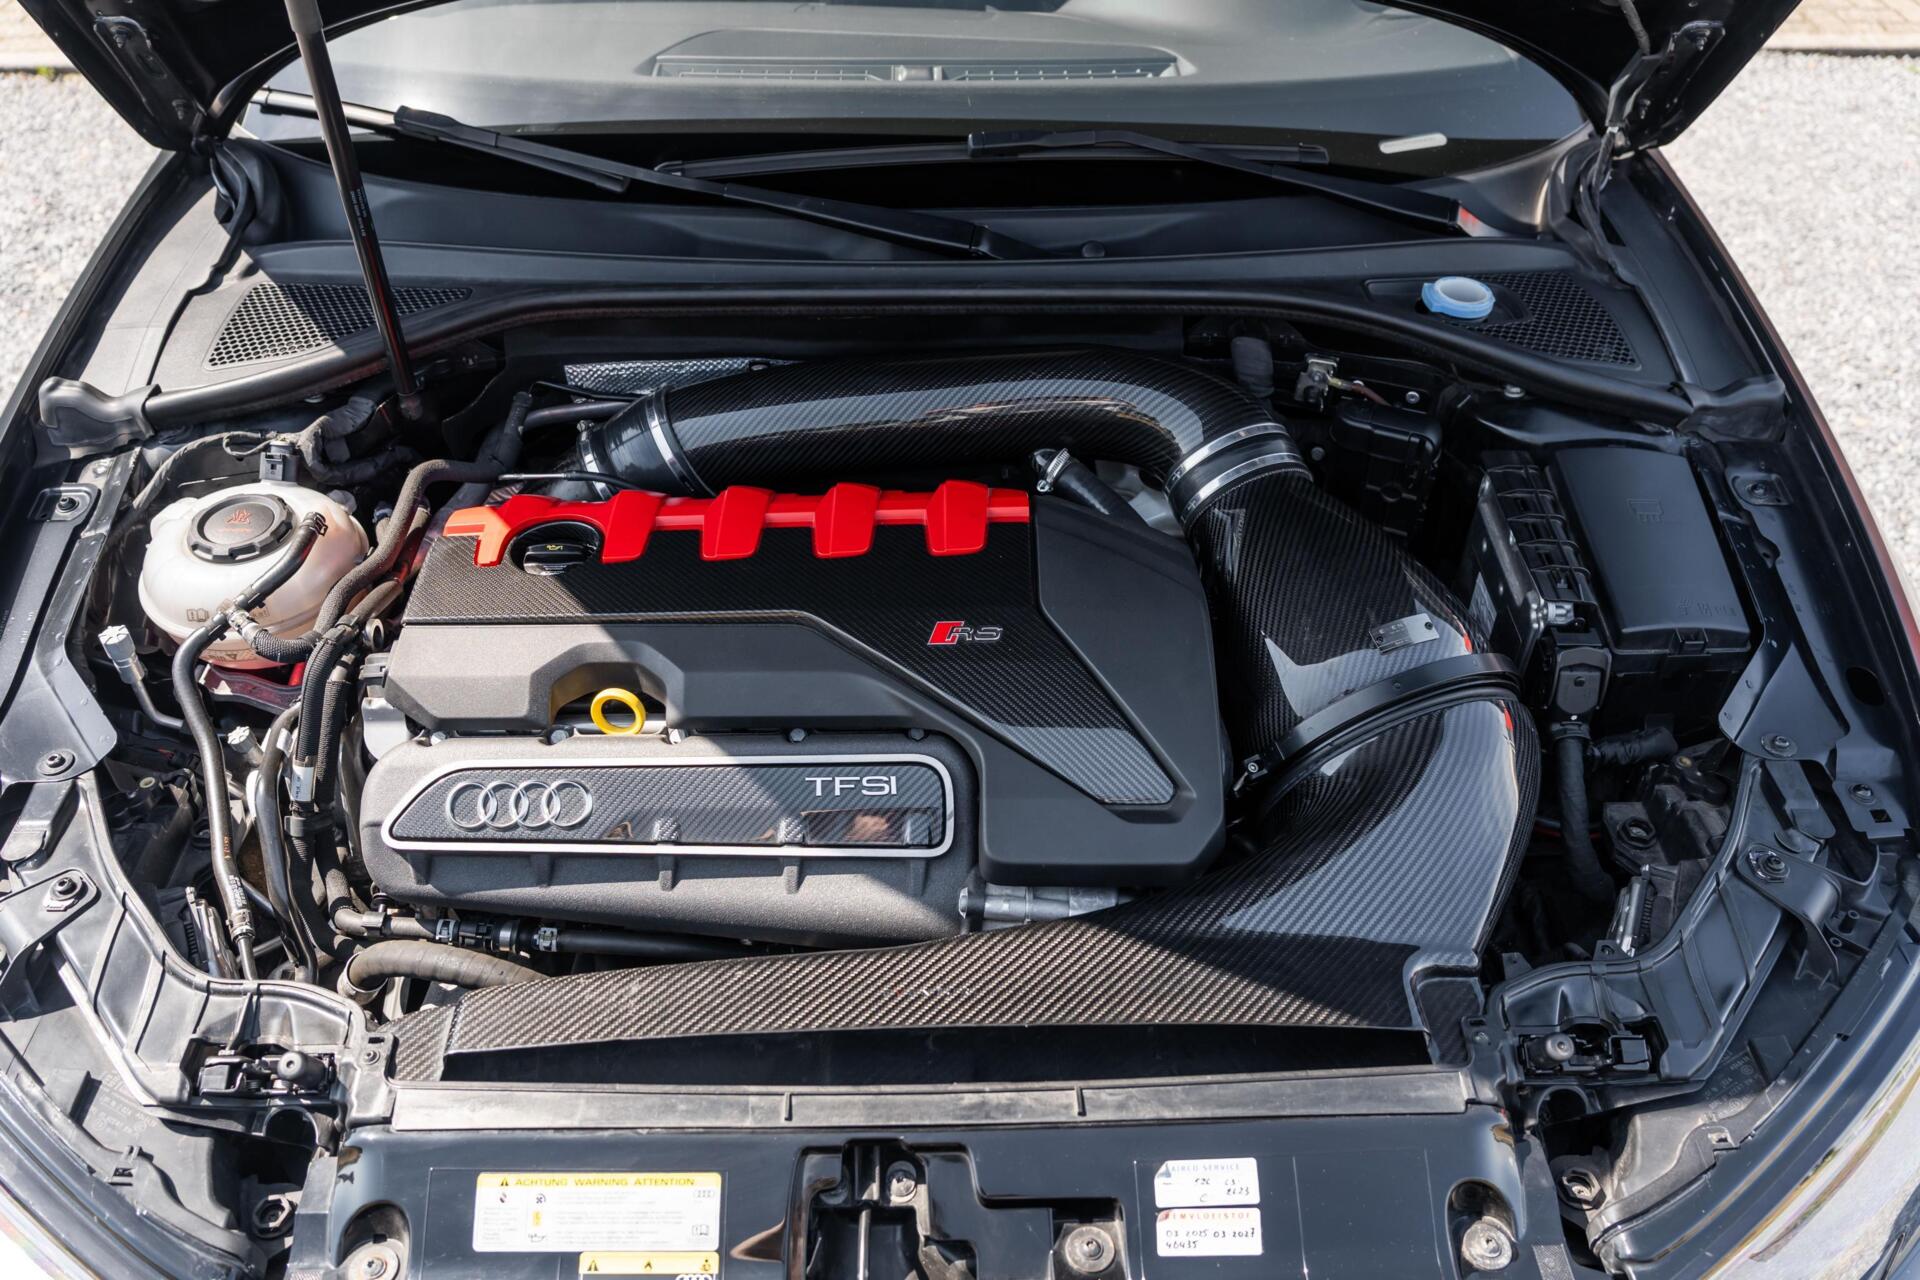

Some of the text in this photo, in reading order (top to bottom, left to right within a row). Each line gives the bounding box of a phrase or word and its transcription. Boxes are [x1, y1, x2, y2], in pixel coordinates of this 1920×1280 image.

[945, 626, 1003, 642] RS
[805, 775, 898, 797] TFSI
[1202, 1163, 1240, 1172] SERVICE
[515, 1177, 696, 1187] ACHTUNG WARNING ATTENTION
